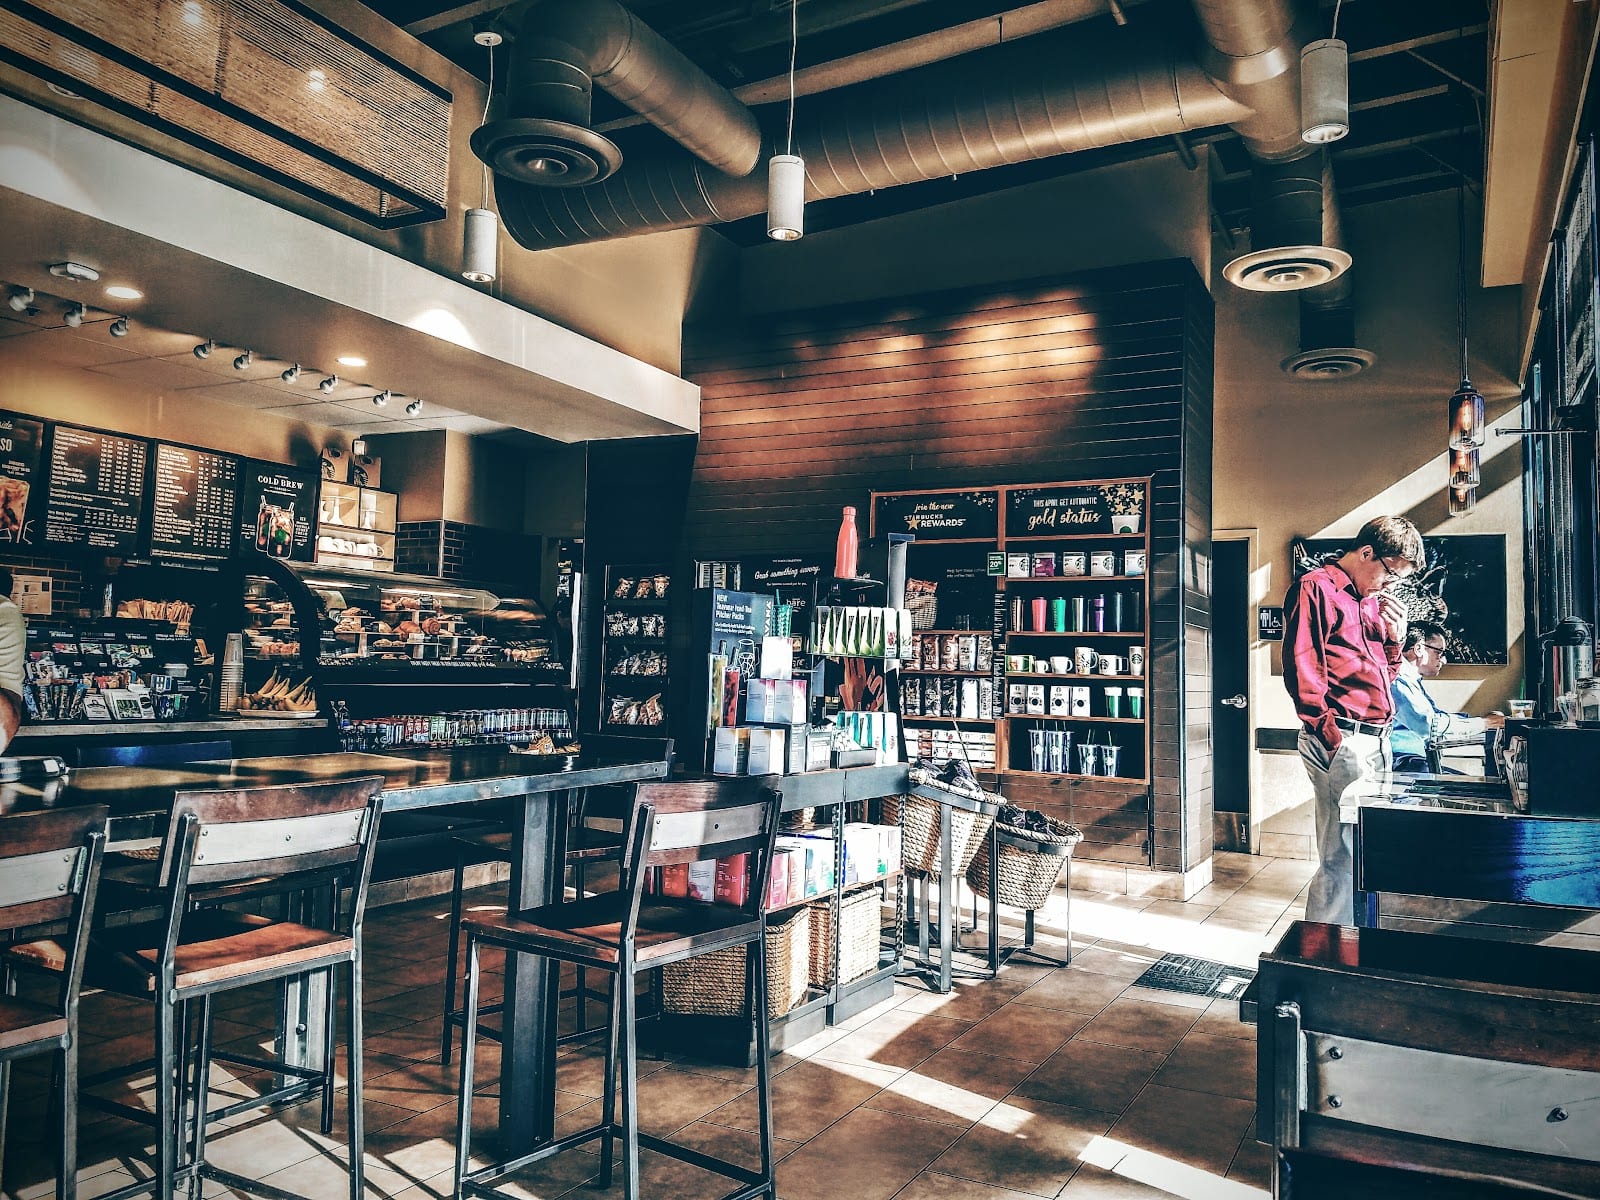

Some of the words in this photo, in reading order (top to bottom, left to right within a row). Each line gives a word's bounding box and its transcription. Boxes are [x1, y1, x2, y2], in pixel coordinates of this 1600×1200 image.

[257, 475, 279, 486] COLD
[281, 479, 304, 490] BREW
[1059, 498, 1069, 506] GET
[1069, 496, 1098, 506] AUTOMATIC
[913, 503, 928, 514] join
[929, 501, 941, 511] the
[903, 513, 944, 521] STRBUCKS
[1027, 507, 1057, 531] gold
[1059, 507, 1102, 525] status
[754, 571, 769, 580] Grab
[769, 566, 799, 578] something
[716, 593, 728, 602] NEW
[786, 599, 806, 607] bare
